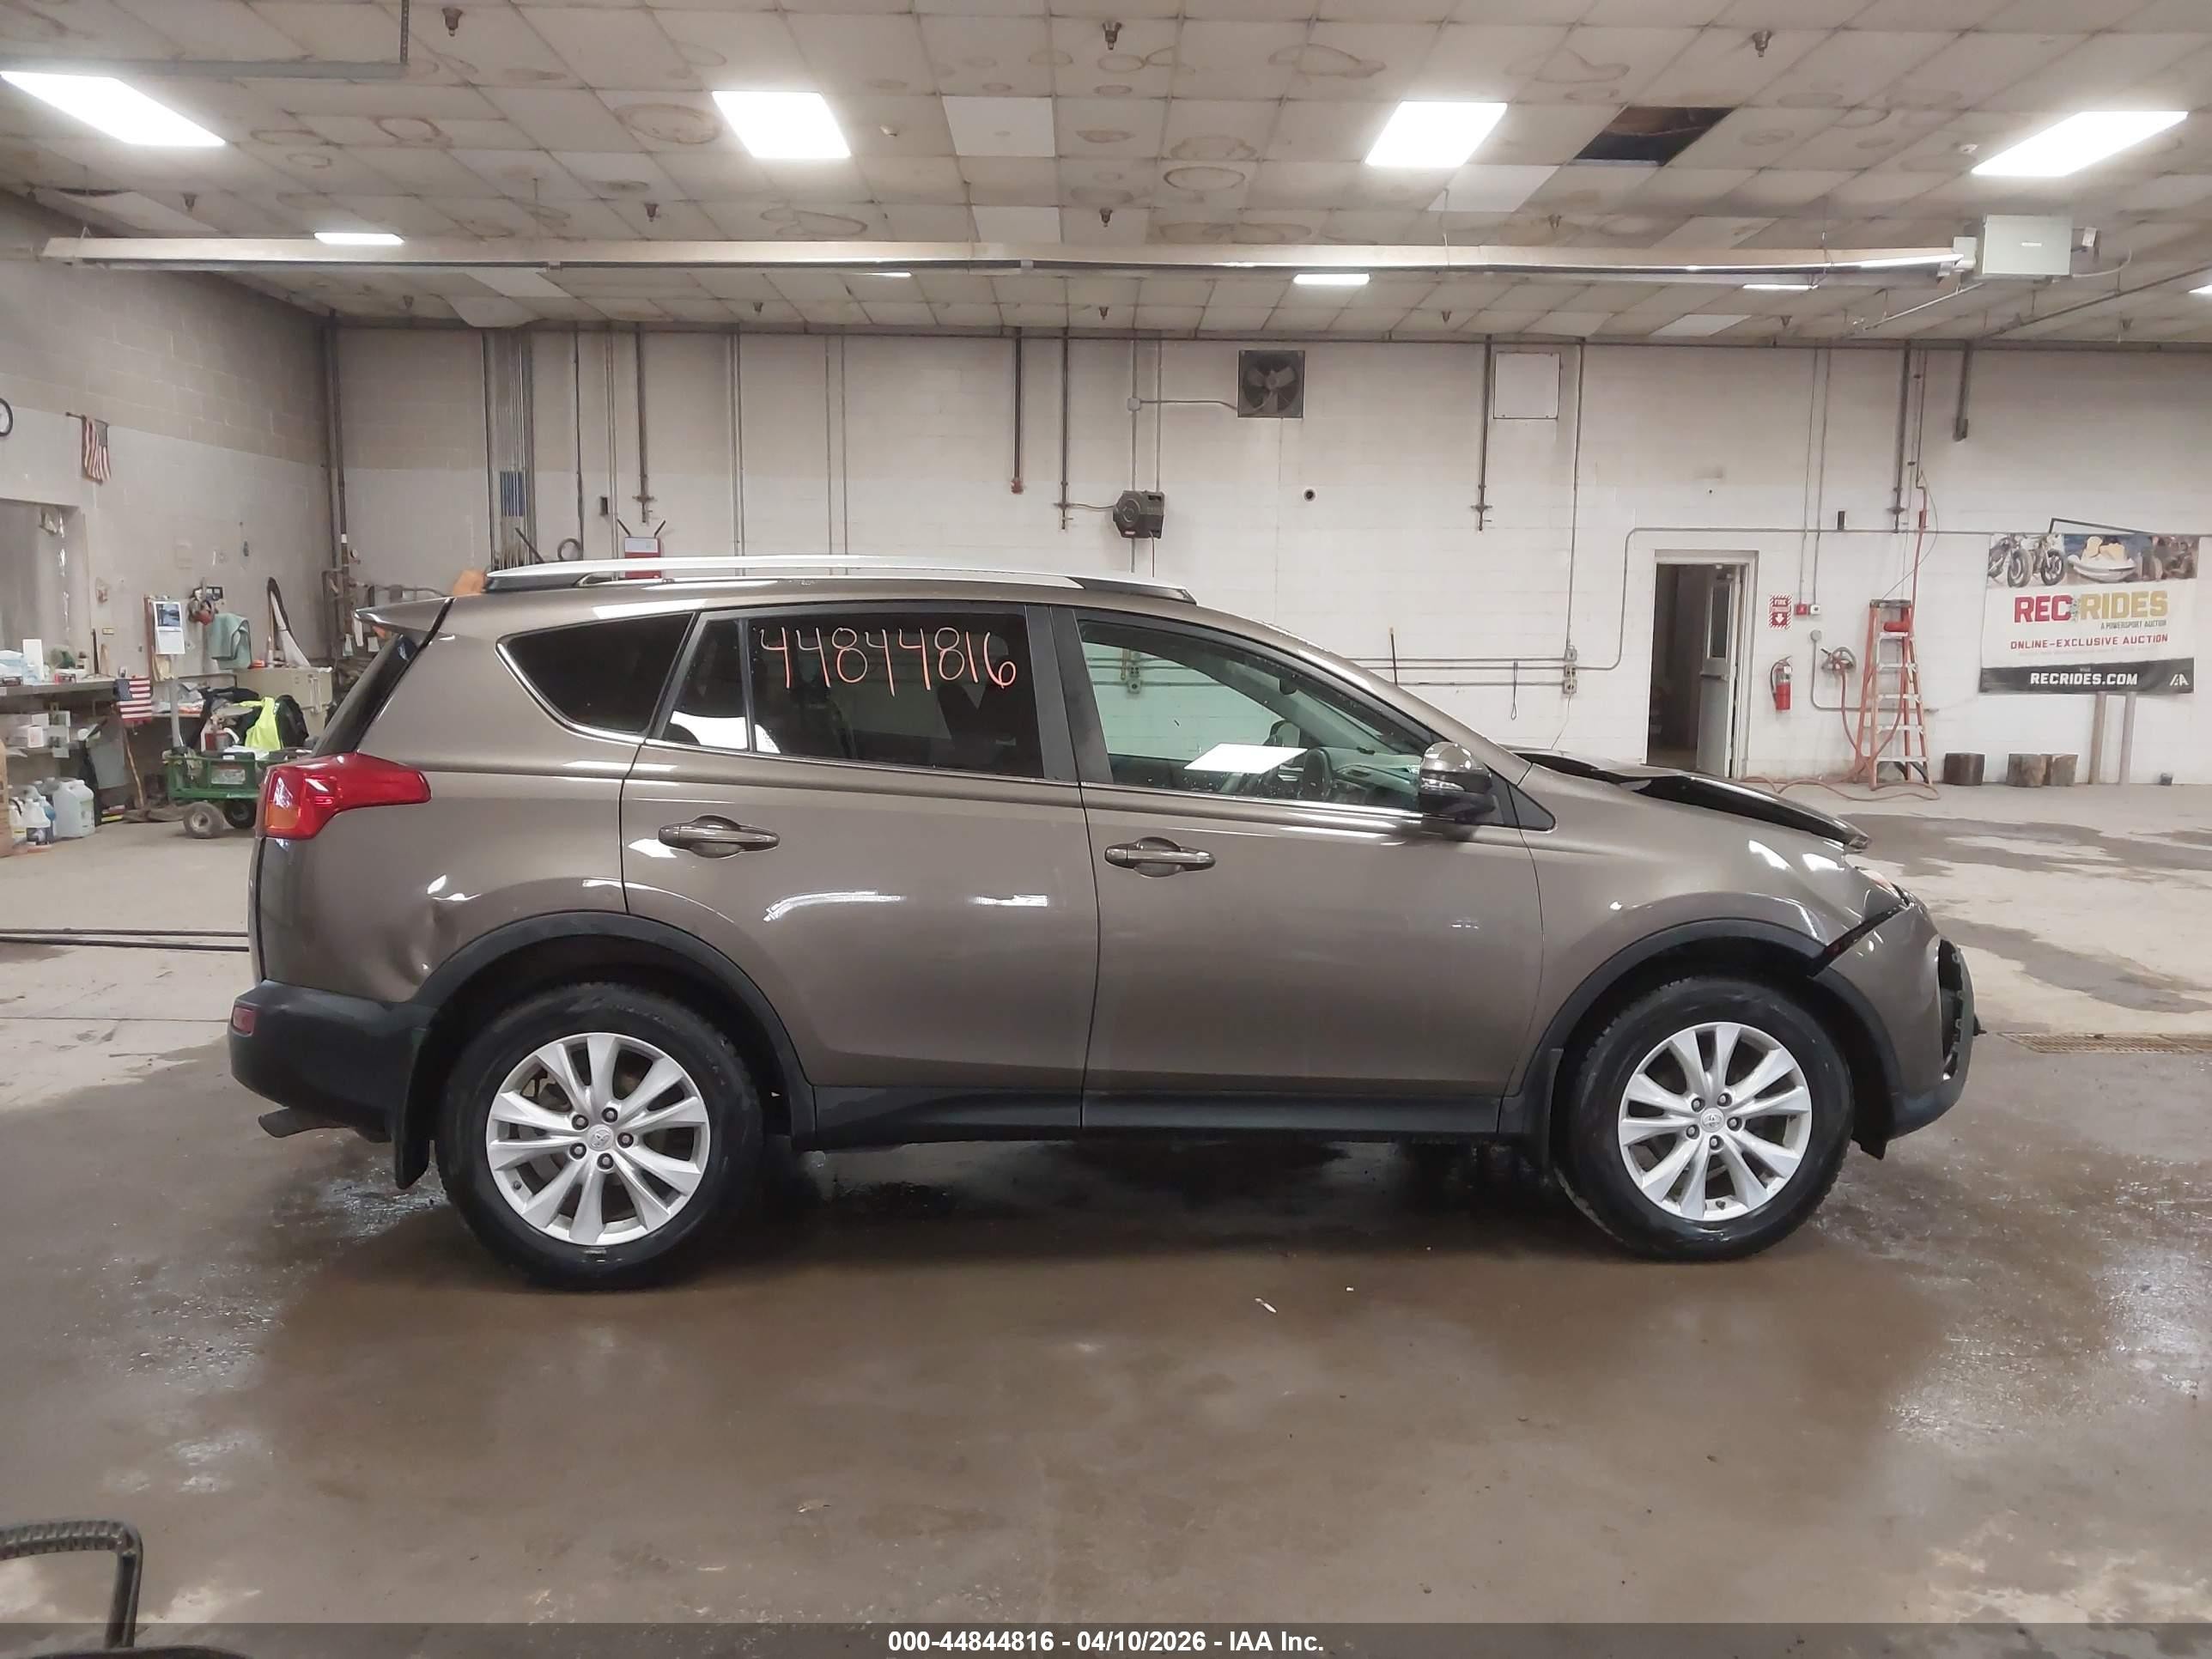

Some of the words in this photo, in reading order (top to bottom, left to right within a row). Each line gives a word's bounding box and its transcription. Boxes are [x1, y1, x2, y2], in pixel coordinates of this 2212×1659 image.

[2014, 595, 2072, 623] REC
[2080, 591, 2168, 619] RIDES
[2010, 636, 2118, 650] ONLINE-EXCLUSIVE
[2122, 634, 2168, 646] AUCTION
[758, 627, 1017, 697] 44844816
[2030, 672, 2138, 686] RECRIDES.COM
